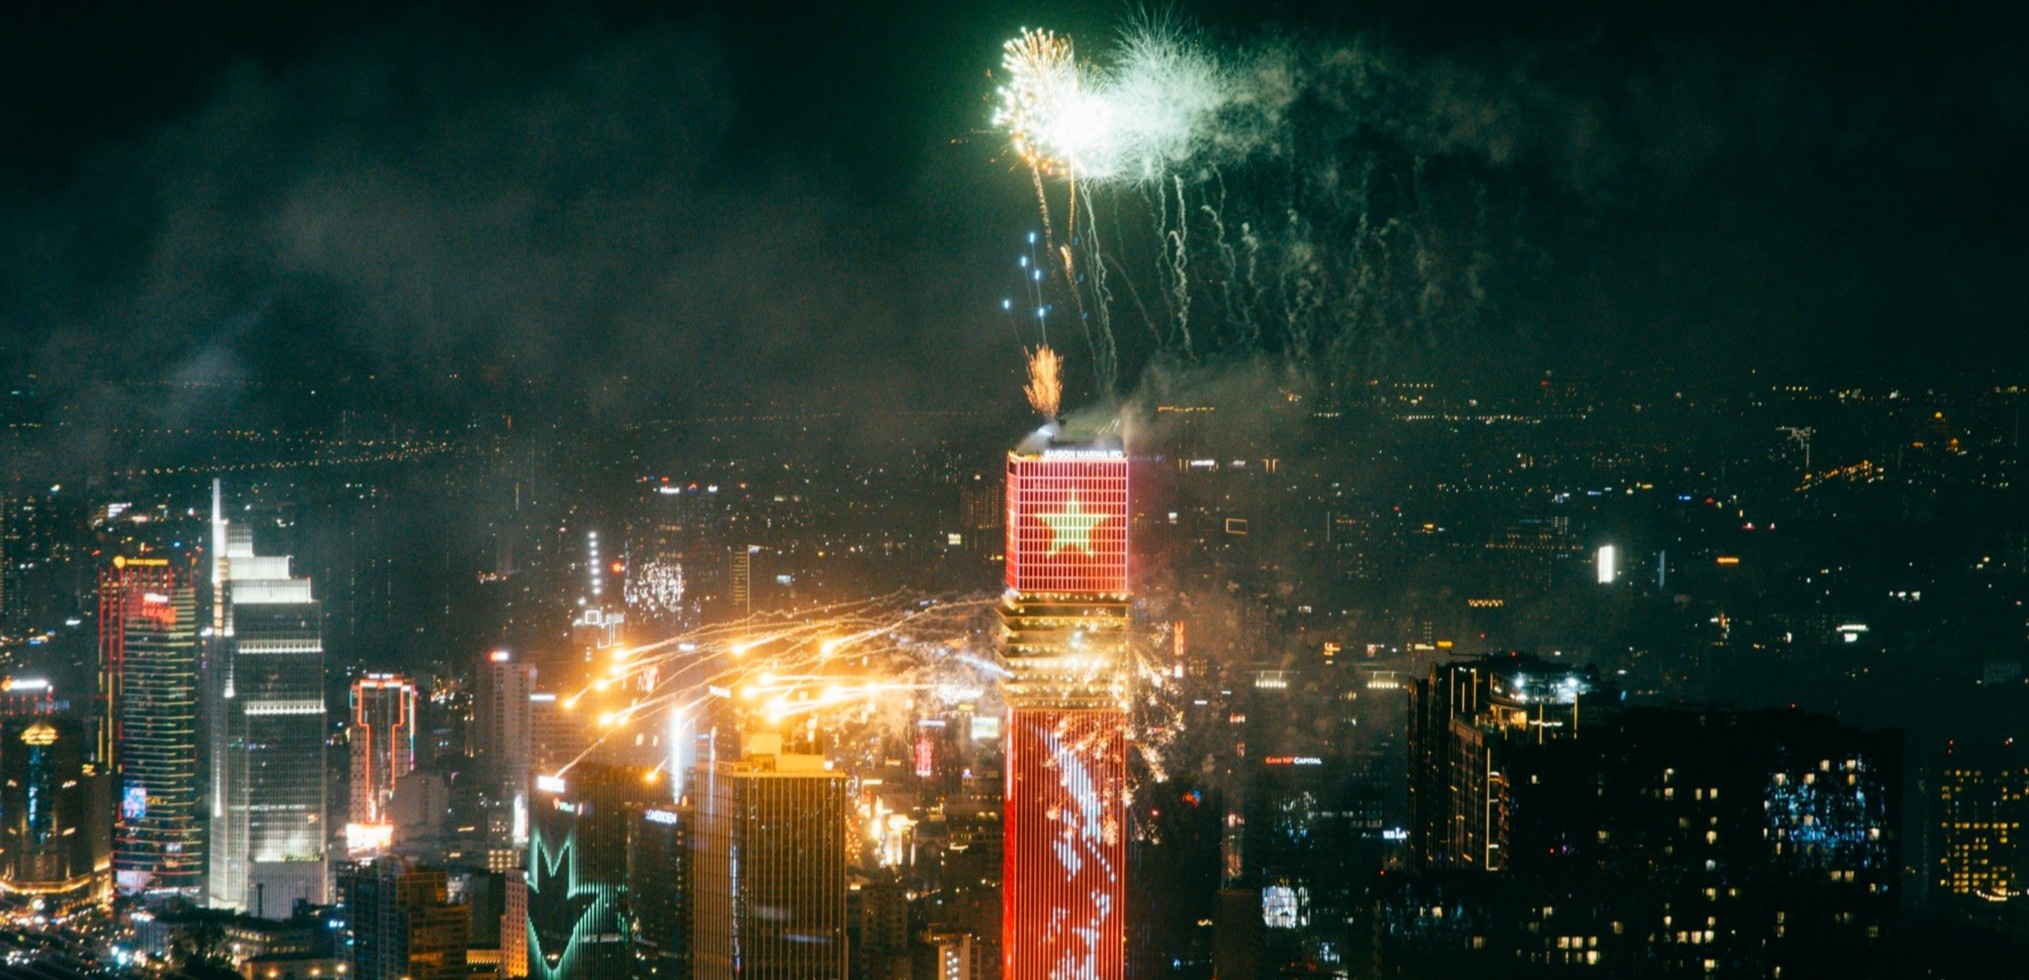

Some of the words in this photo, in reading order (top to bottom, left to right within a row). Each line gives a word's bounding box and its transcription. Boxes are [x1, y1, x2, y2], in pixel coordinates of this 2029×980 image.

[1044, 450, 1075, 460] SAIGON
[1076, 450, 1108, 460] MARINA
[1293, 757, 1322, 765] CAPITAL
